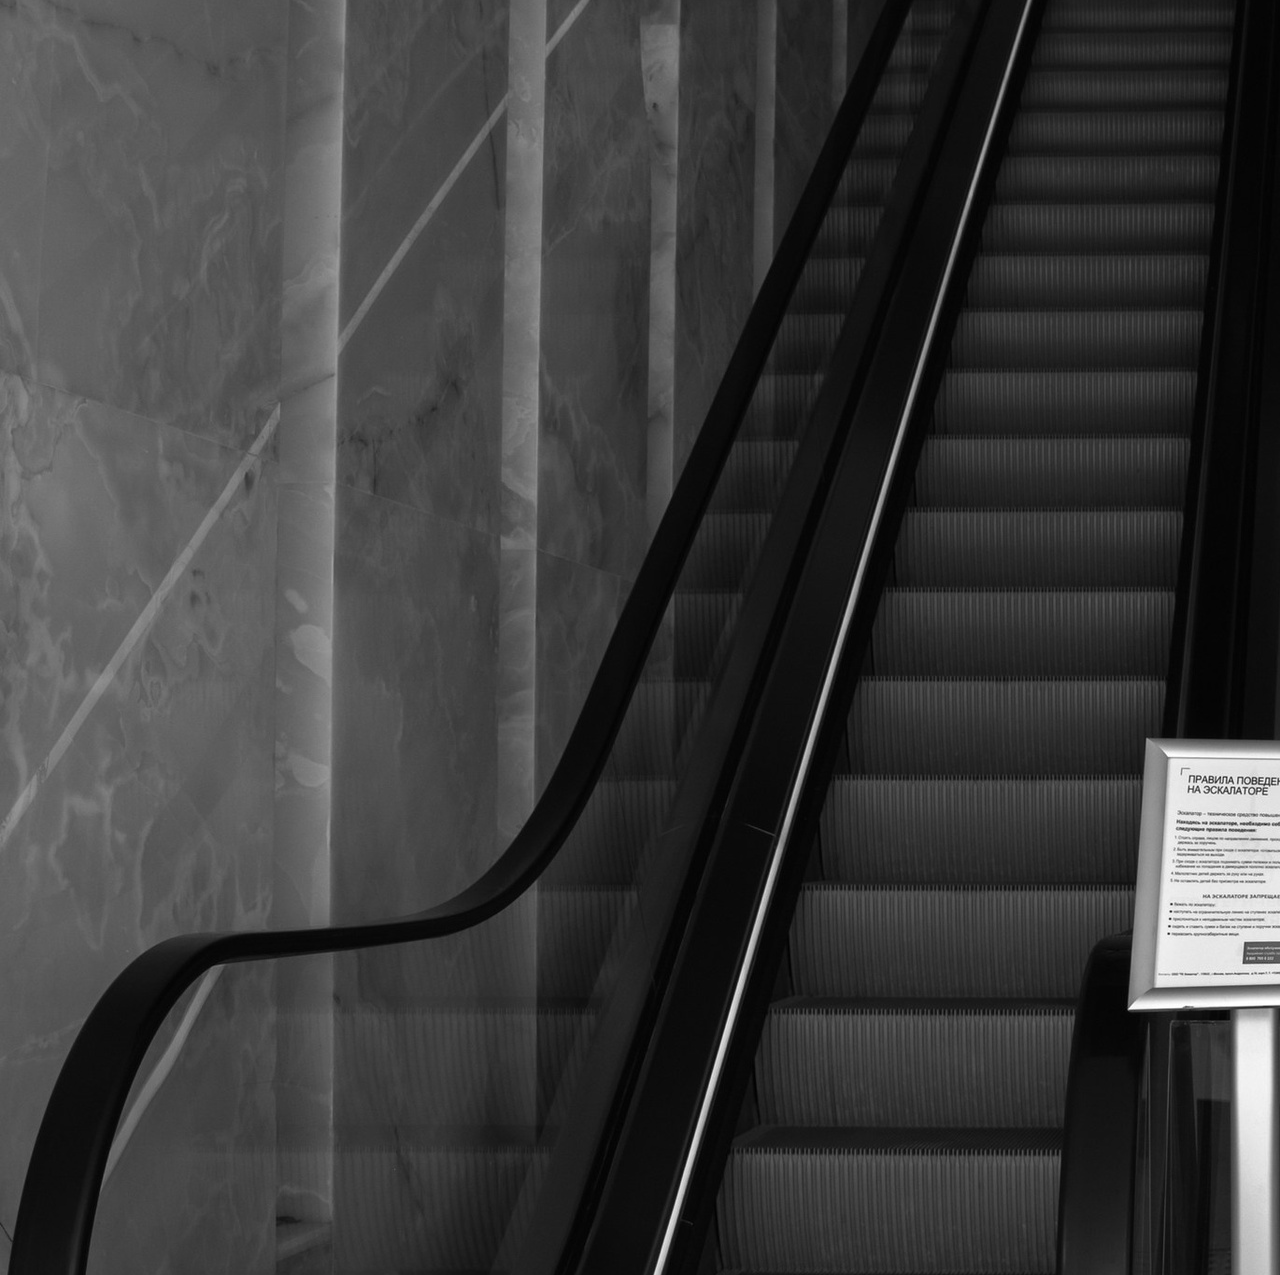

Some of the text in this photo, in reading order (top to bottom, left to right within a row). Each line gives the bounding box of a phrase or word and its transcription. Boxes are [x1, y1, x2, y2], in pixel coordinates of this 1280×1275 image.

[1188, 775, 1234, 785] ПРАВИЛА
[1188, 786, 1268, 796] НА ЭСКАЛАТОРЕ
